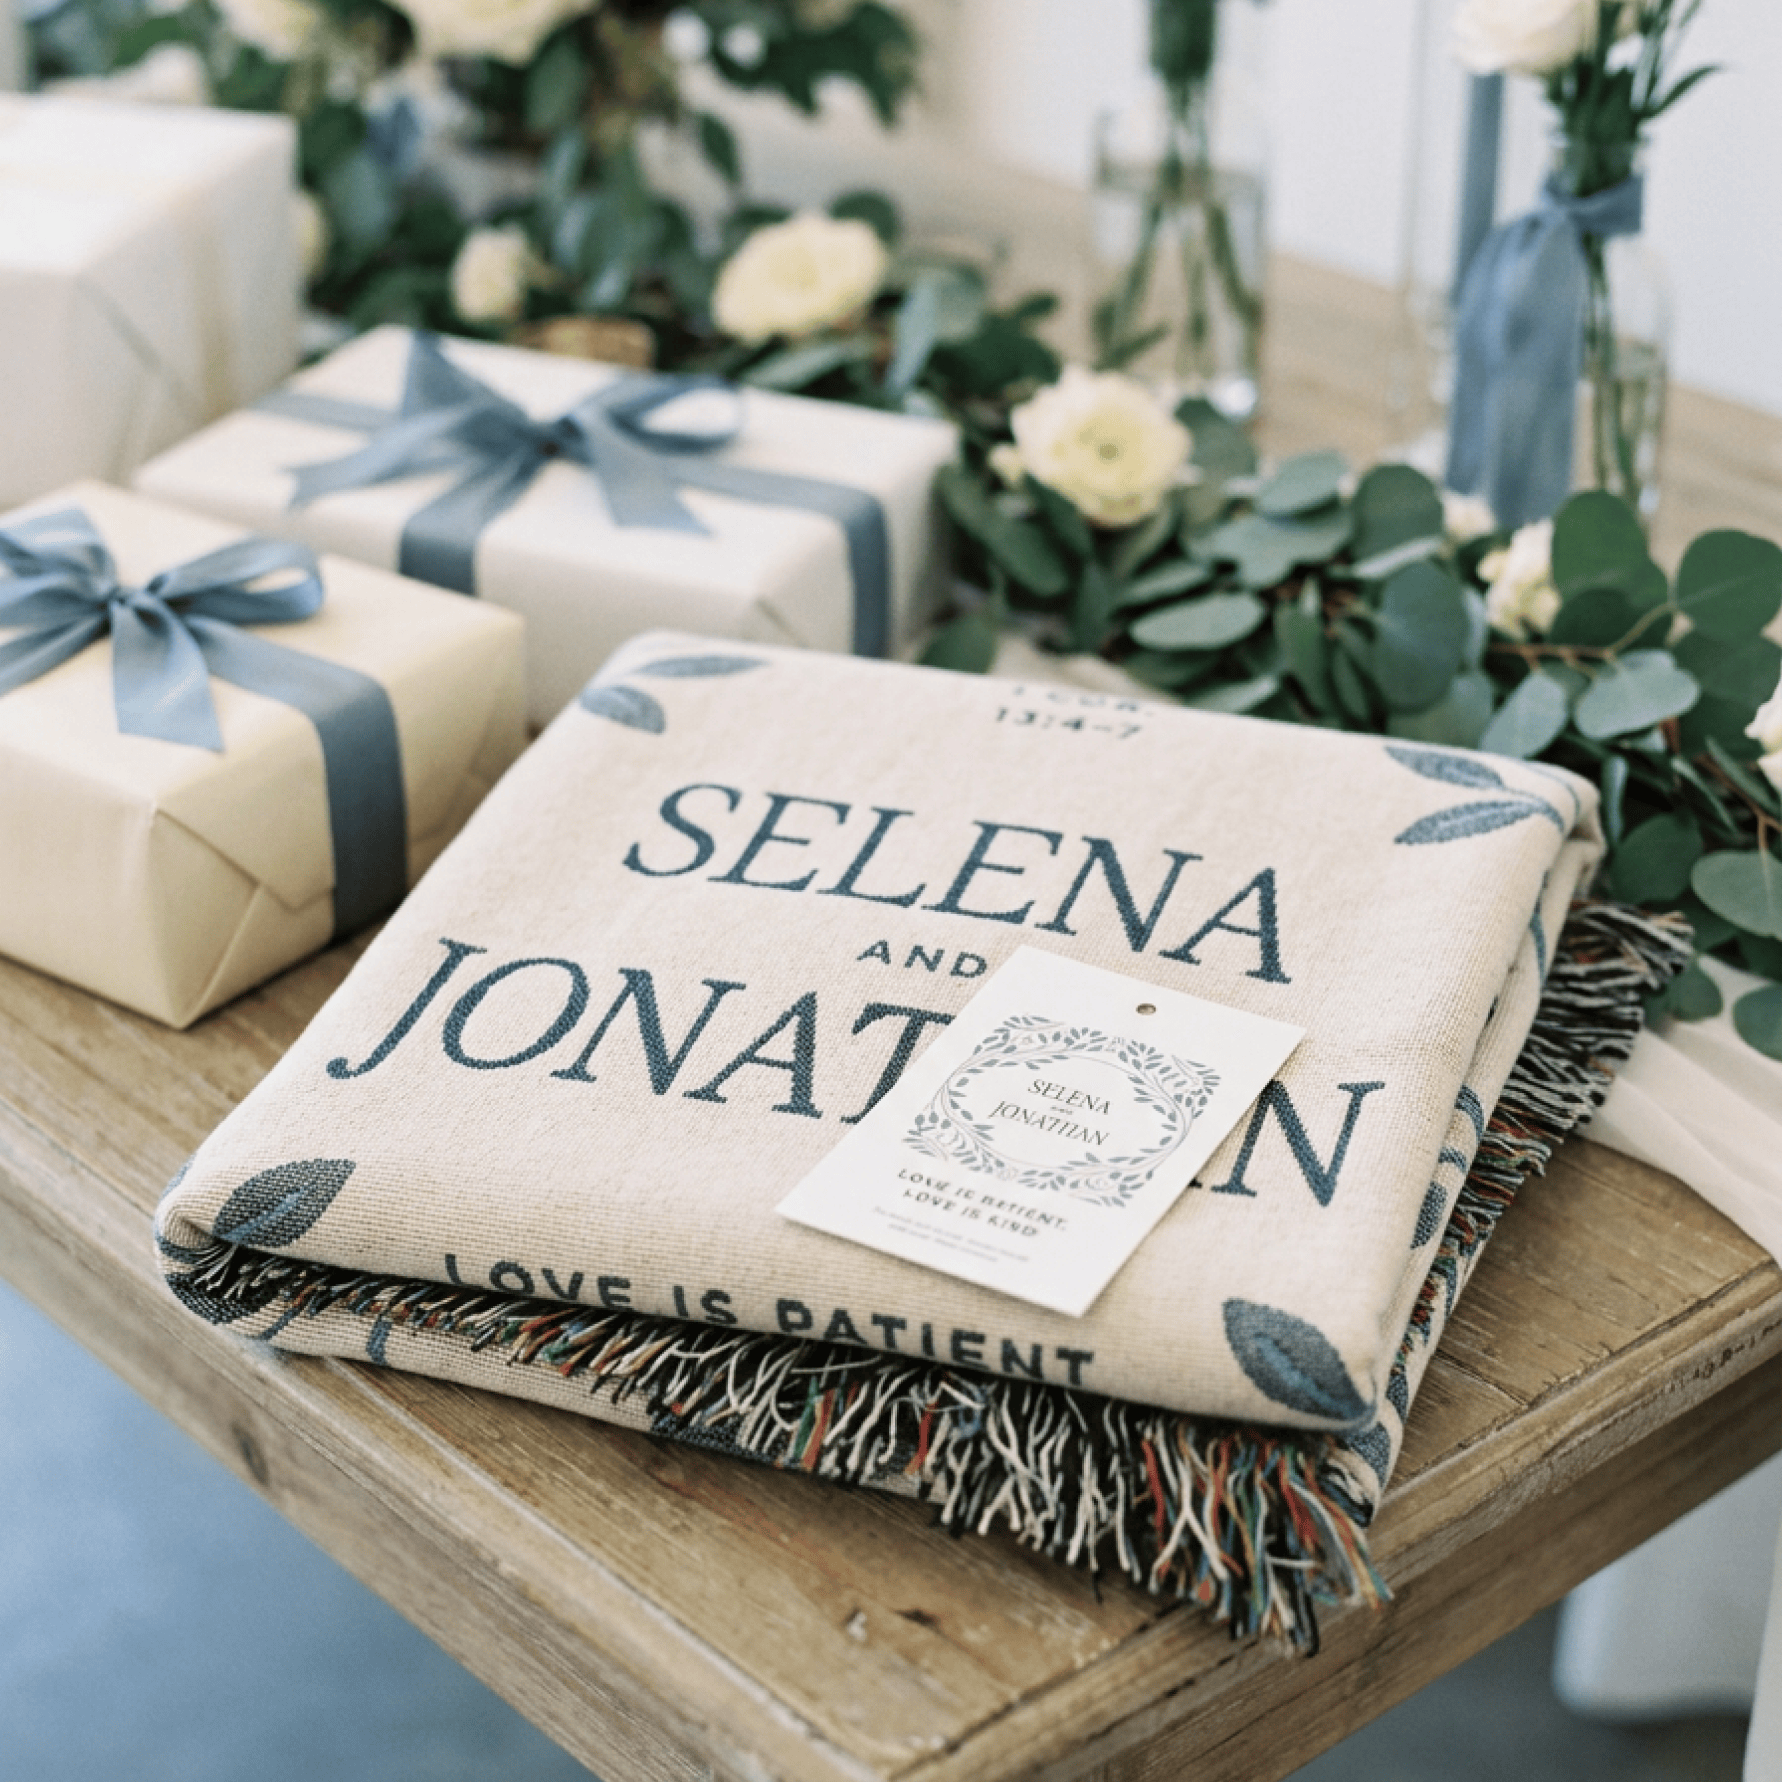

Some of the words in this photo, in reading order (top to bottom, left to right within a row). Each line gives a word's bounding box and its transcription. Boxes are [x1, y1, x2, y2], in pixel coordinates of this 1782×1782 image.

[622, 785, 1293, 985] SELENA
[855, 939, 989, 980] AND
[326, 938, 1386, 1208] JONATN
[1027, 1078, 1111, 1115] SELENA
[673, 1285, 738, 1325] IS
